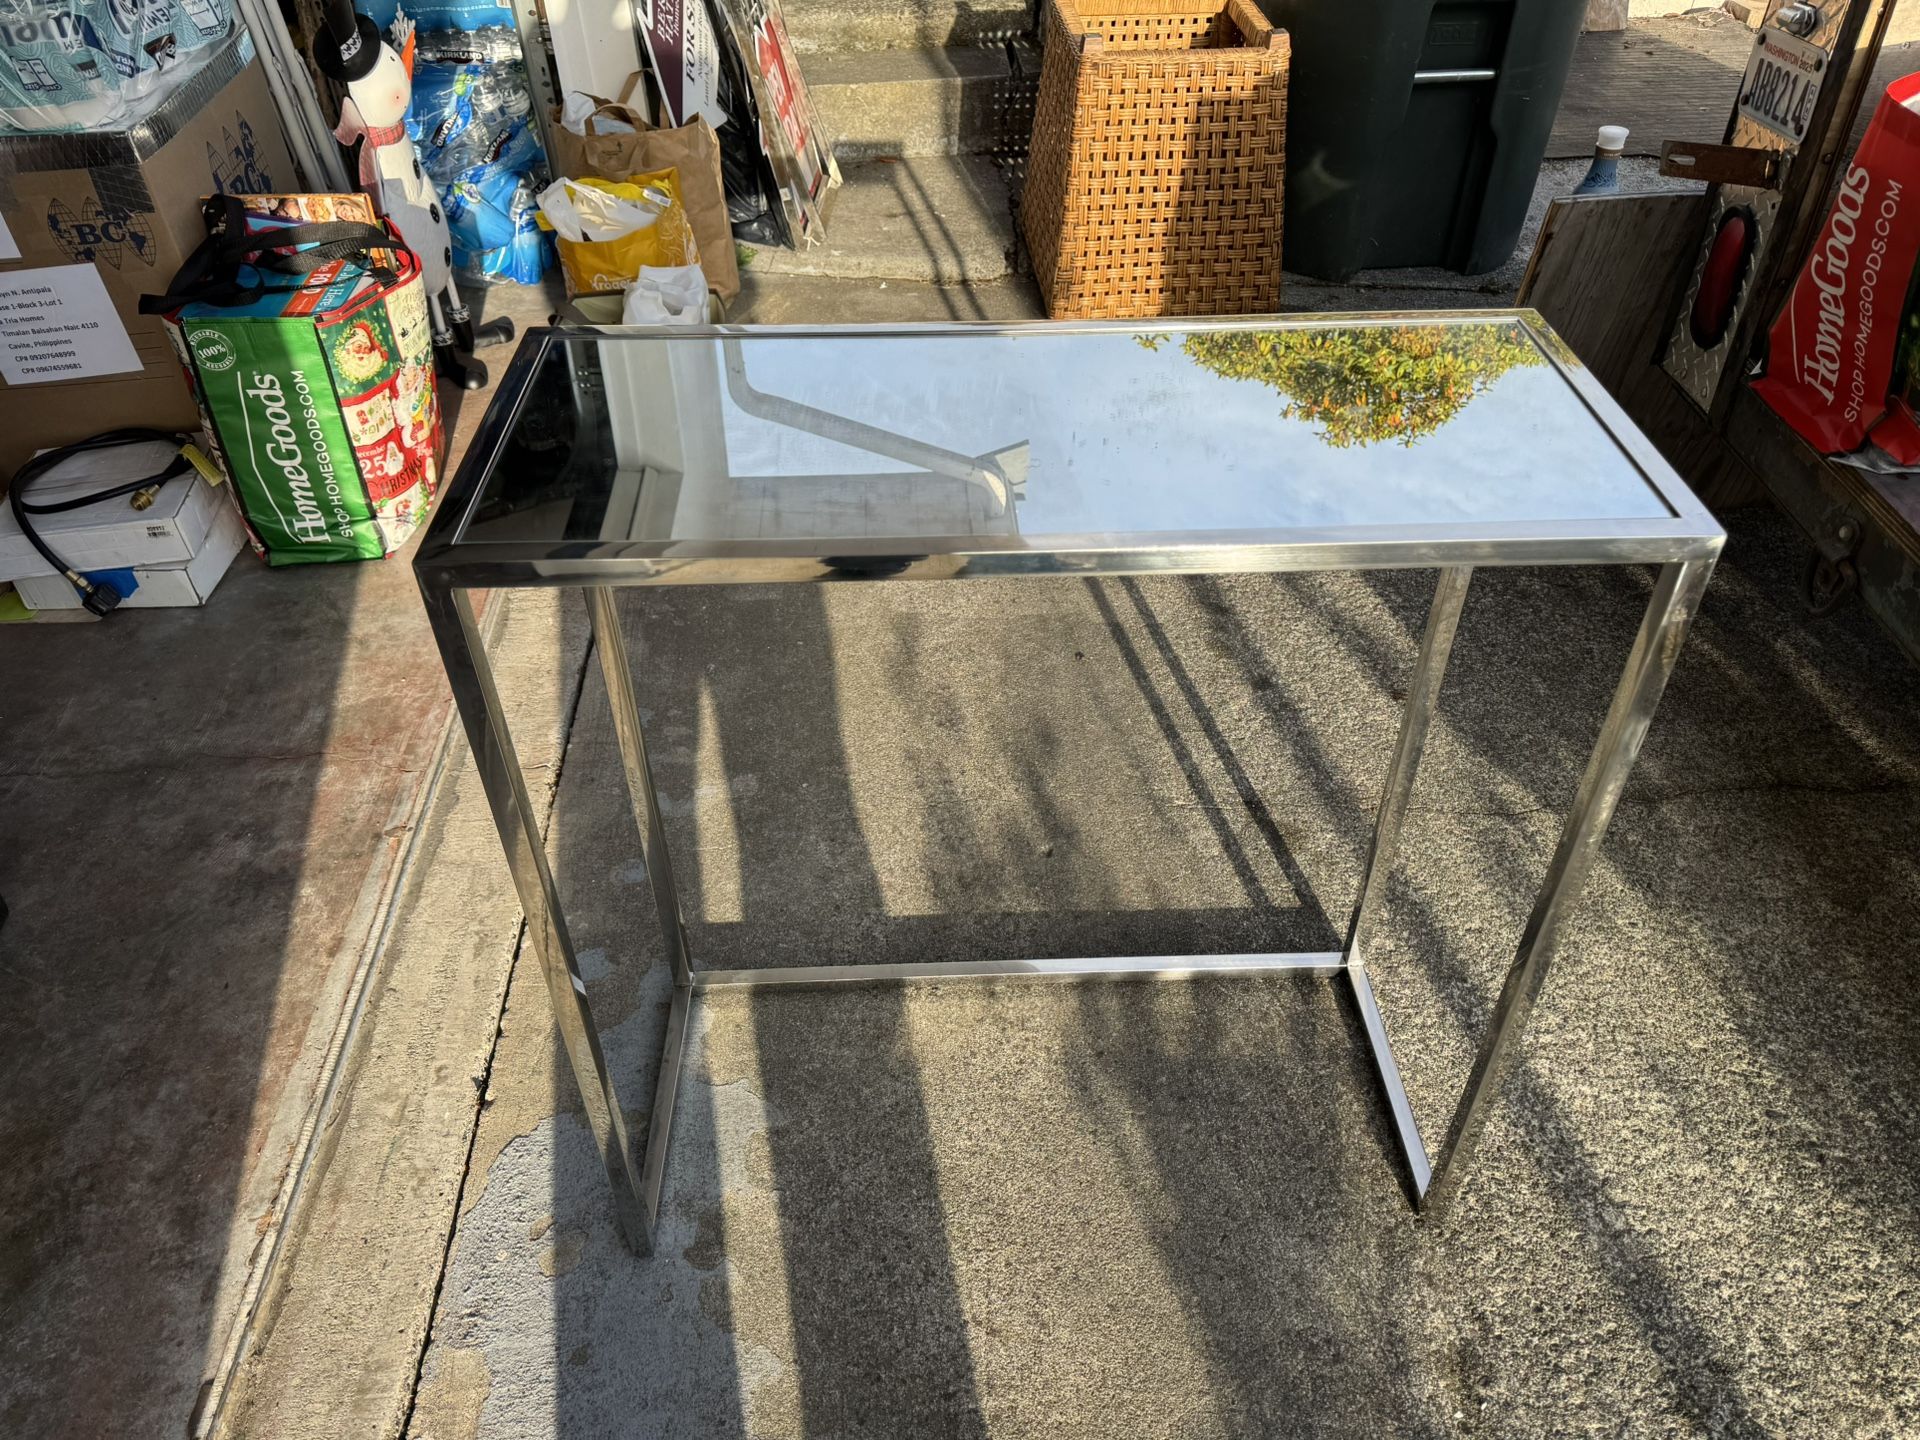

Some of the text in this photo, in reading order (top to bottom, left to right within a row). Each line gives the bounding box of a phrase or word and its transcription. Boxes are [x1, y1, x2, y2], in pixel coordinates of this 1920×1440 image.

[436, 51, 483, 60] KIRKLAND
[686, 28, 696, 86] FOR
[1764, 42, 1799, 66] WASHINGTON
[1844, 178, 1903, 423] SHOP HOMEGOODS.COM
[20, 315, 45, 324] Homes
[81, 321, 99, 330] 4110
[197, 343, 227, 359] 100%
[245, 372, 332, 544] HomeGoods
[290, 370, 354, 538] SHOP HOMEGOODS.COM
[360, 454, 387, 478] 25
